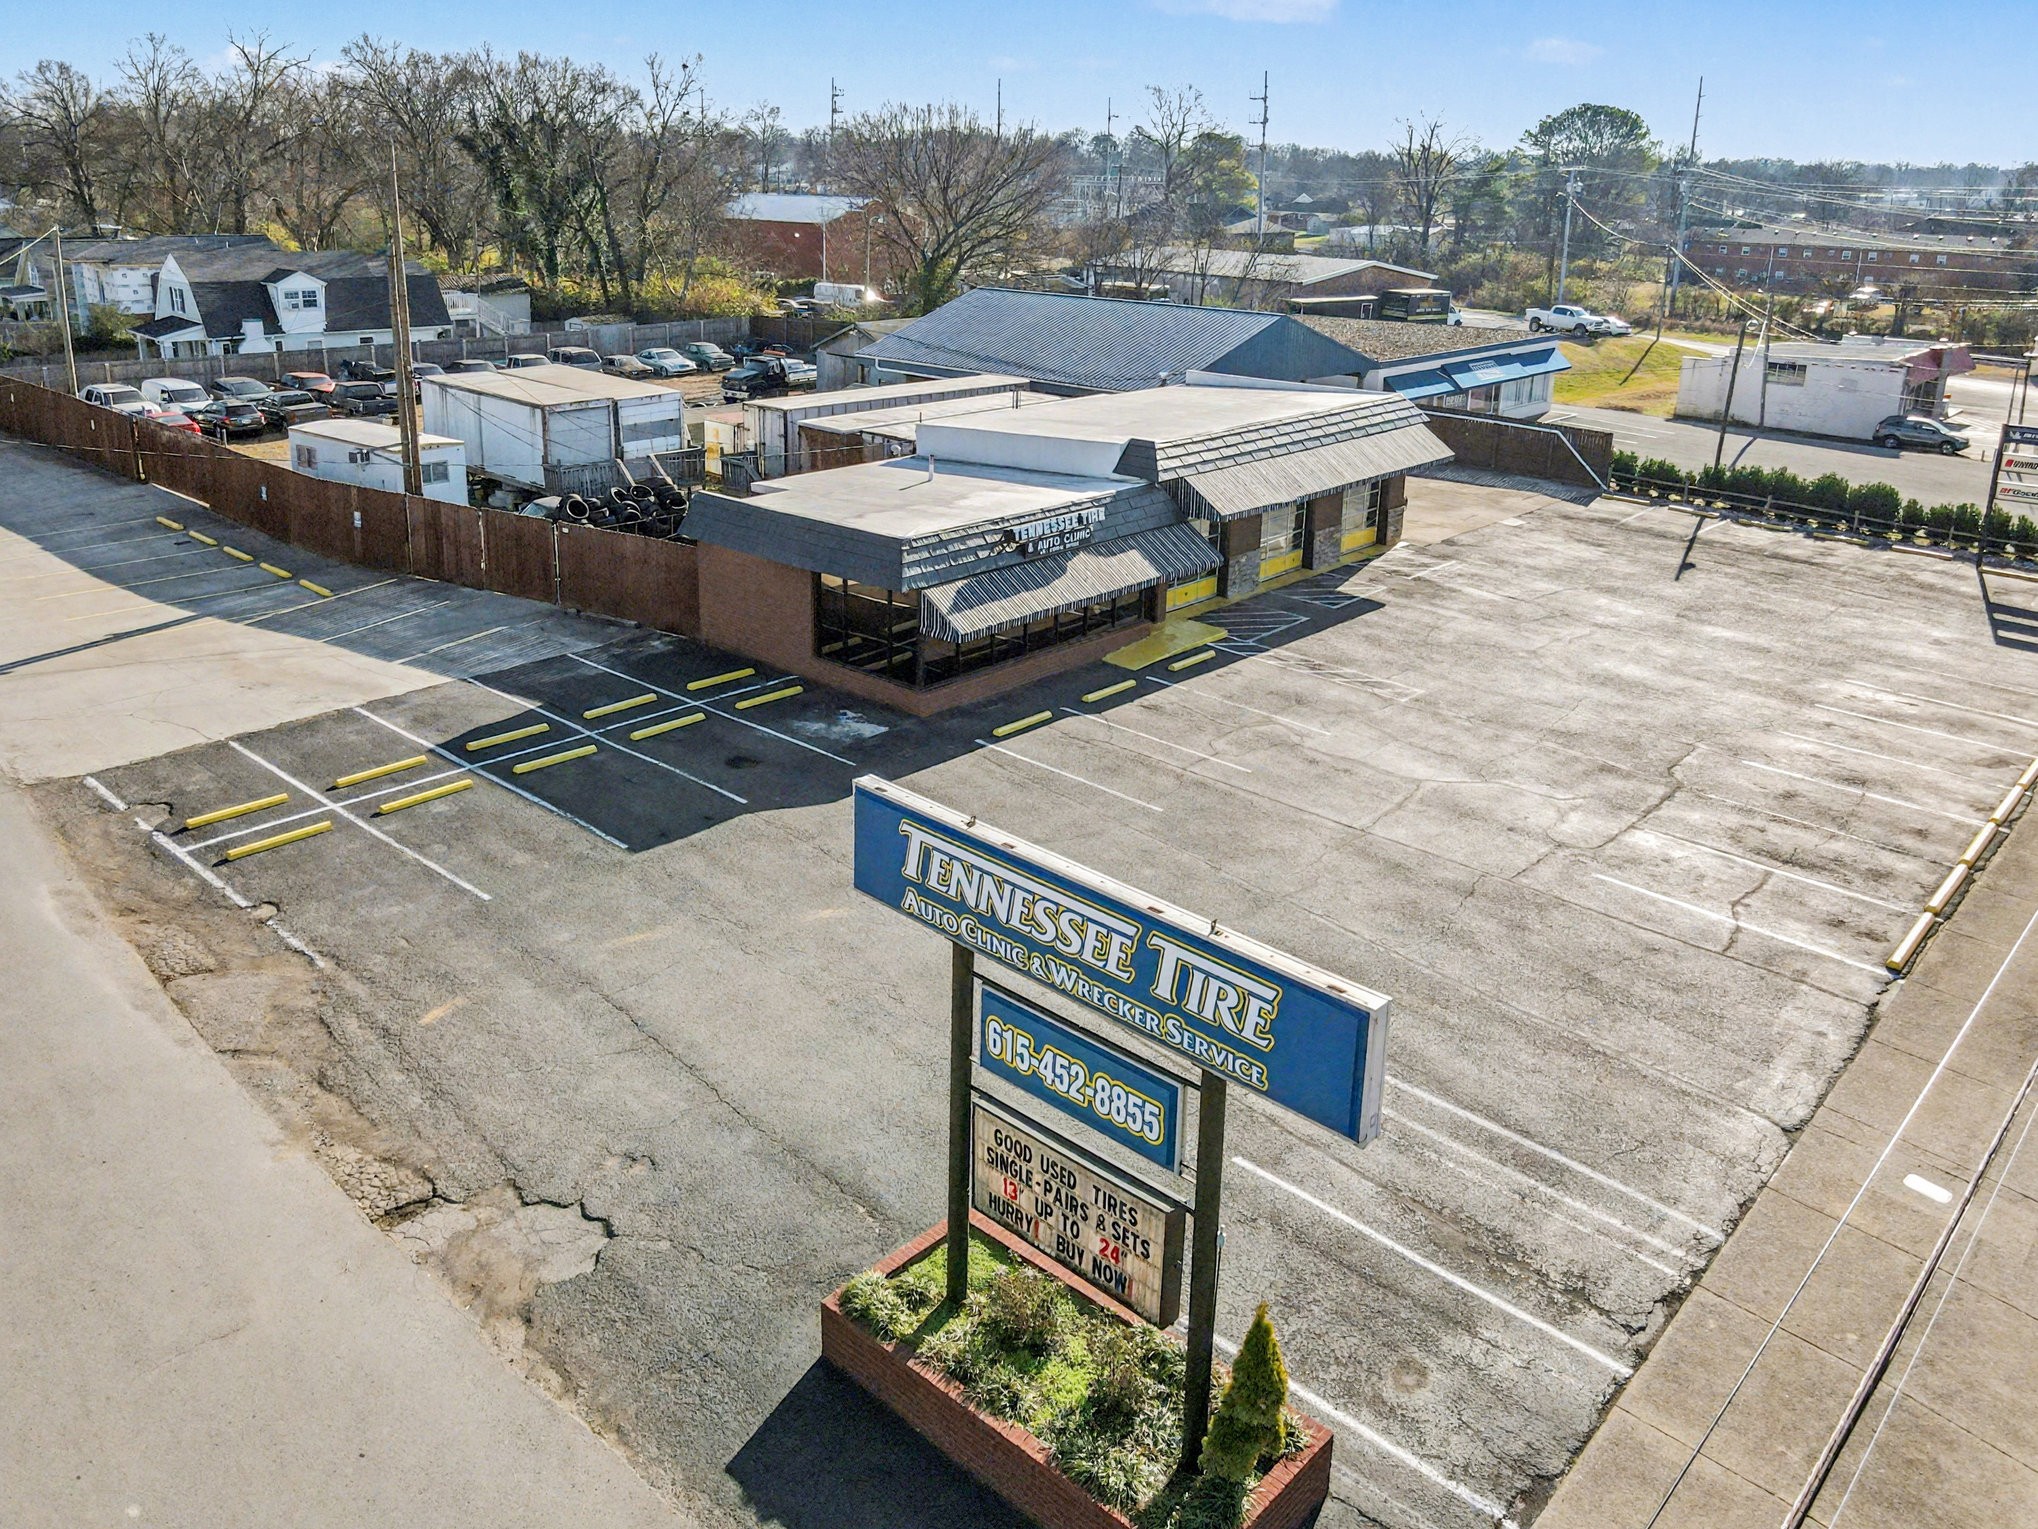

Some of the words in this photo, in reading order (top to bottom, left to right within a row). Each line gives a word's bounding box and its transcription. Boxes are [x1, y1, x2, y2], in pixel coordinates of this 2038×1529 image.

[1013, 513, 1079, 541] TENNESSEE
[1081, 507, 1106, 525] TIRE
[1038, 537, 1060, 551] AUTO
[1063, 528, 1091, 544] CLINIC
[900, 820, 1141, 982] TENNESSEE
[1148, 931, 1282, 1050] TIRE
[901, 887, 959, 935] AUTO
[960, 916, 1028, 970] CLINIC
[1029, 954, 1047, 978] &
[1046, 955, 1163, 1038] WRECKER
[1163, 1014, 1269, 1092] SERVICE
[987, 1017, 1163, 1143] 615-452-8855
[994, 1128, 1033, 1164] GOOD
[1040, 1153, 1077, 1190] USED
[1093, 1184, 1138, 1227] TIRES
[1035, 1196, 1053, 1221] UP
[1061, 1215, 1080, 1240] TO
[988, 1191, 1040, 1239] HURRY!
[1056, 1233, 1085, 1267] BUY
[1092, 1256, 1133, 1298] NOW!
[1095, 1213, 1106, 1232] &
[1111, 1220, 1151, 1260] SETS
